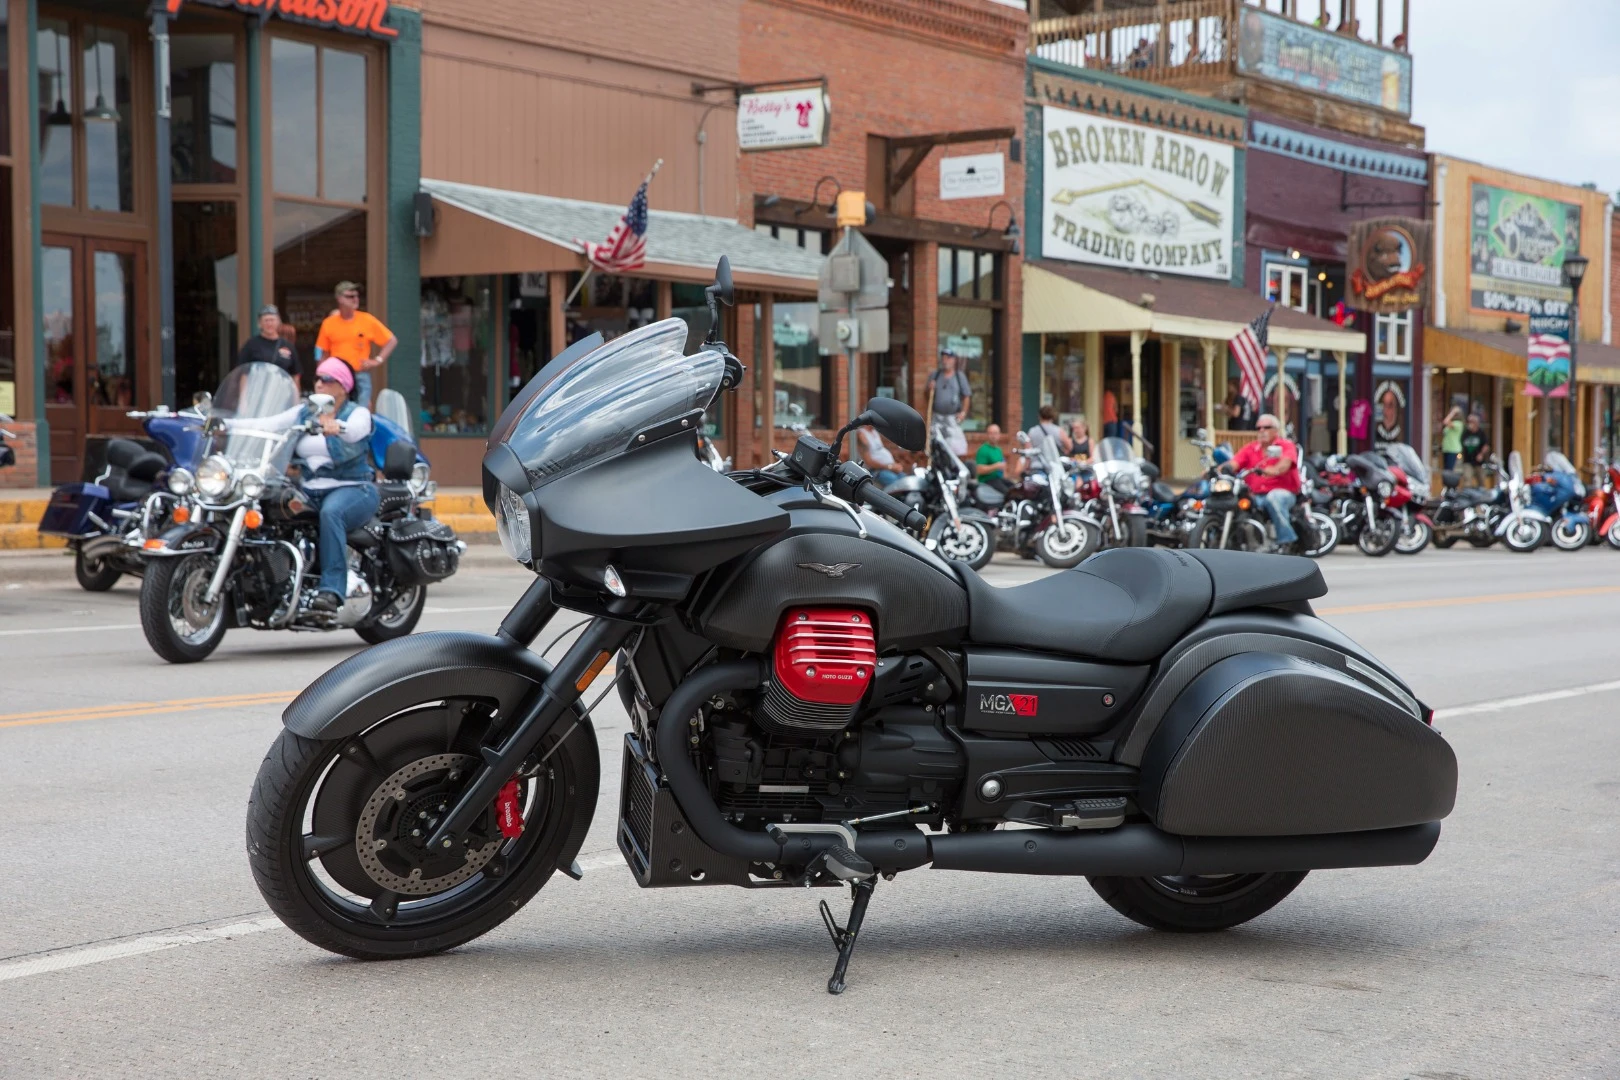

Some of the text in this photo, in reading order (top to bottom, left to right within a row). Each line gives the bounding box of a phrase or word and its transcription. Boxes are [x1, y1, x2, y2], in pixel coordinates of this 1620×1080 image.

[1048, 125, 1230, 197] BROKEN ARROW
[1052, 213, 1222, 267] TRADING COMPANY
[1543, 299, 1569, 316] OFF
[980, 693, 1036, 713] MGX 21
[504, 802, 513, 827] brembo
